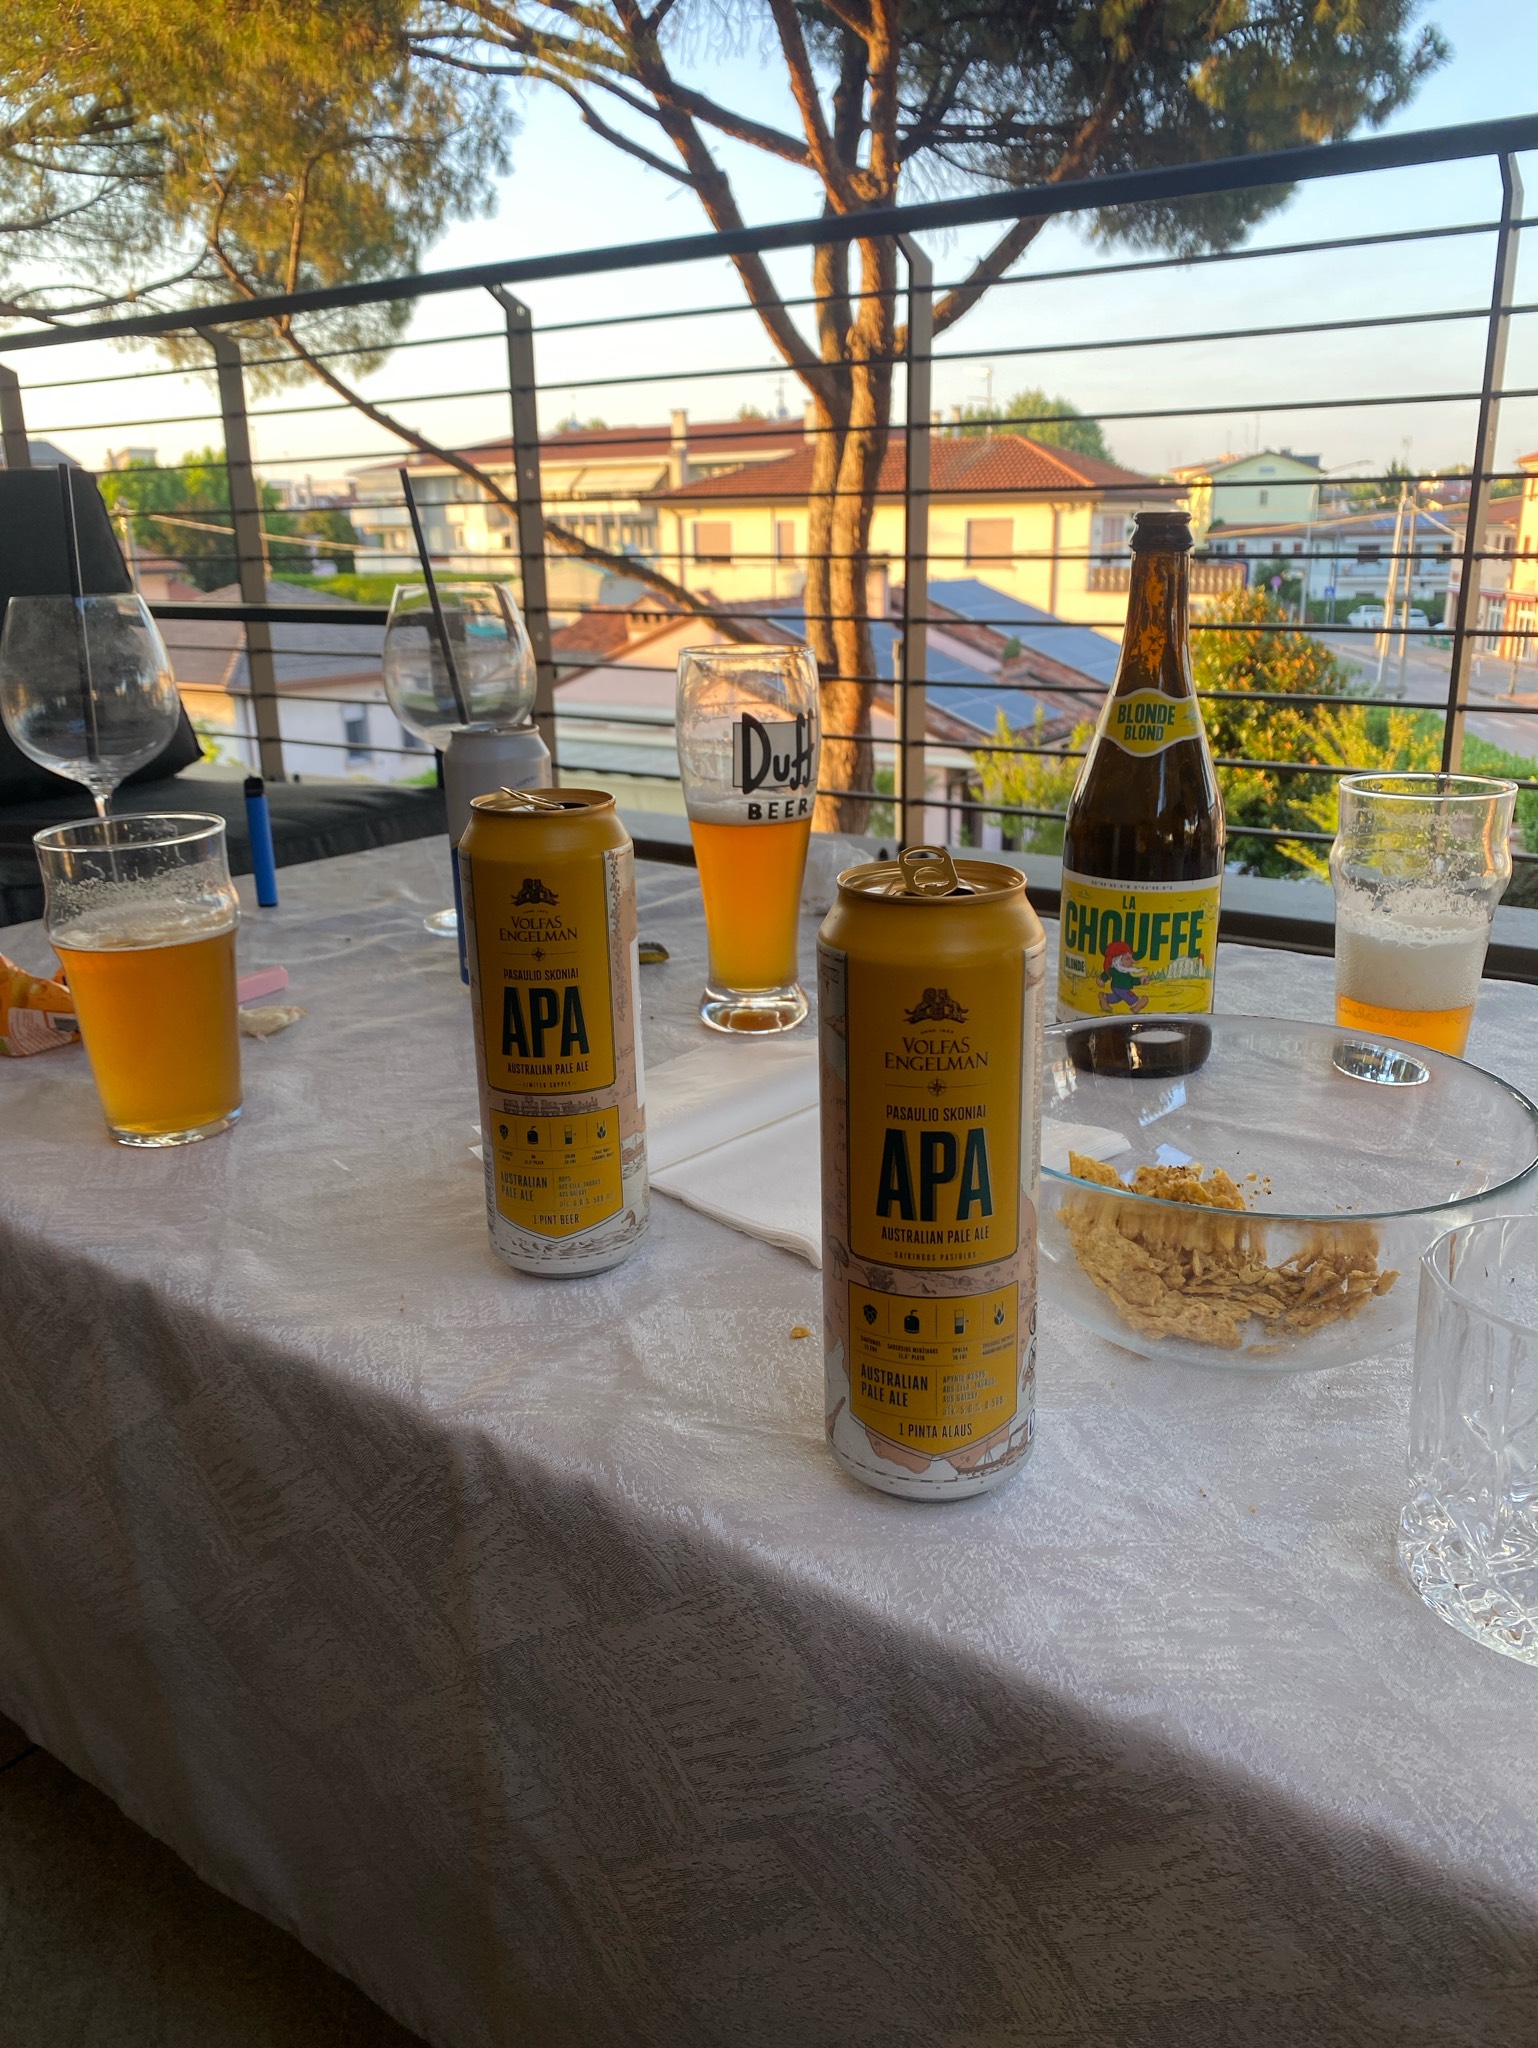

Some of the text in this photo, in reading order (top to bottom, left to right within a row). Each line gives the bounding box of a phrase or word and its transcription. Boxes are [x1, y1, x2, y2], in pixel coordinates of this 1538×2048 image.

[1117, 703, 1176, 726] BLONDE
[1123, 725, 1165, 741] BLOND
[741, 708, 815, 795] Duff
[748, 798, 808, 820] BEER
[1122, 895, 1136, 909] LA
[511, 916, 562, 930] VOLFAS
[1065, 901, 1204, 961] CHOUFFE
[500, 928, 578, 942] ENGELMAN
[1065, 953, 1085, 972] BLONDE
[503, 968, 579, 981] PASAULIO SKONIAI
[502, 986, 590, 1058] APA
[902, 1037, 970, 1055] VOLFAS
[508, 1061, 589, 1075] AUSTRALIAN PALE ALE
[885, 1052, 988, 1071] ENGELMAN
[886, 1104, 986, 1122] PASAULIO SKONIAI
[501, 1171, 547, 1188] AUSTRALIAN
[876, 1128, 995, 1222] APA
[502, 1185, 534, 1202] PALE ALE
[533, 1213, 580, 1225] 1 PINT BEER
[882, 1225, 989, 1244] AUSTRALIAN PALE ALE
[861, 1363, 928, 1391] AUSTRALIAN
[861, 1381, 908, 1407] PALE ALE
[899, 1423, 972, 1438] 1 PINTA ALAUS
